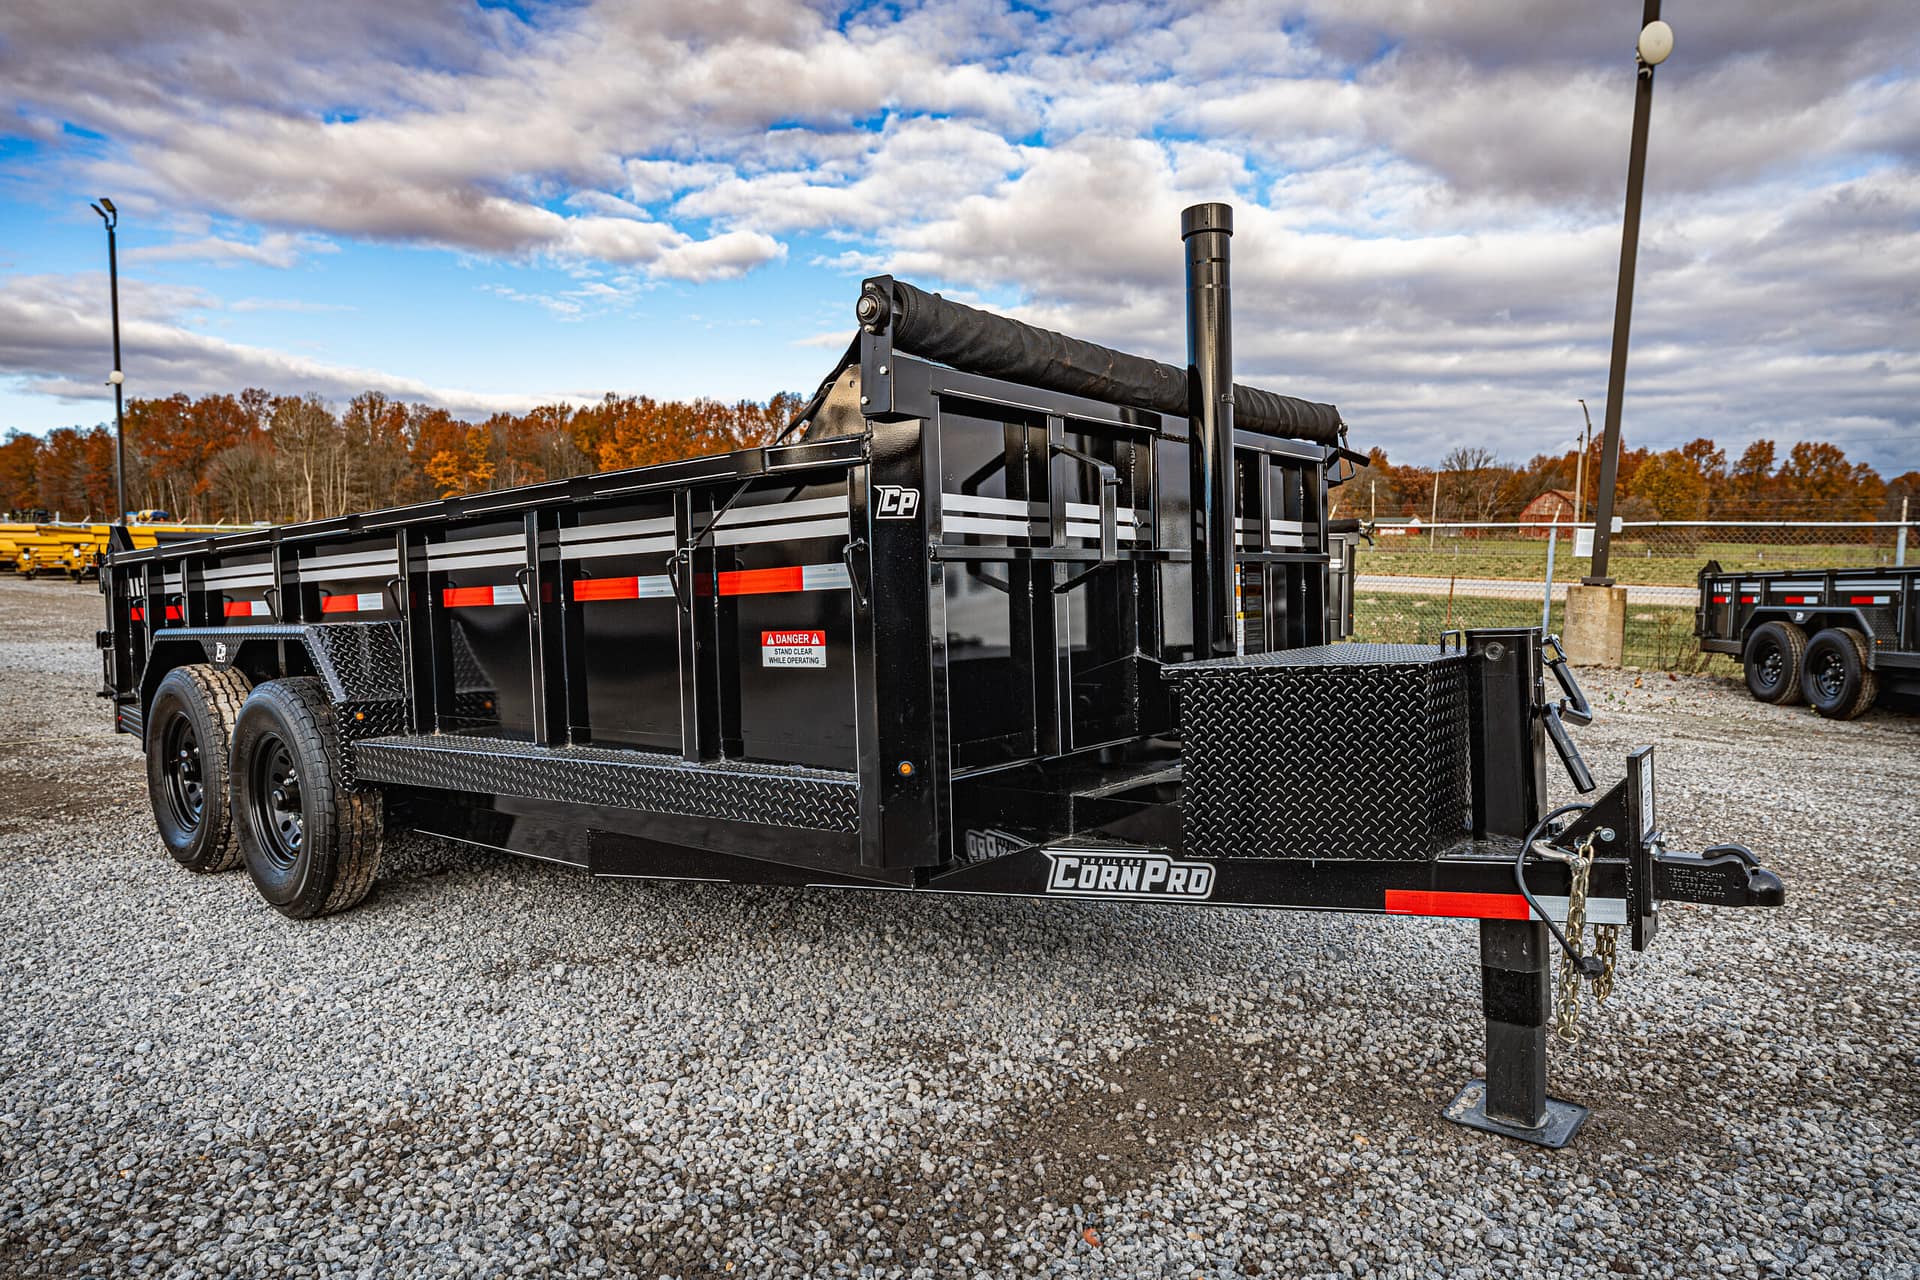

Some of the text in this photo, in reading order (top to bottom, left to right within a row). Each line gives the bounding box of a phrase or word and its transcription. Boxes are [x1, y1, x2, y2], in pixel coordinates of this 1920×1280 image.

[881, 489, 916, 515] CP
[775, 633, 810, 644] DANGER
[1082, 857, 1142, 866] TRAILERS
